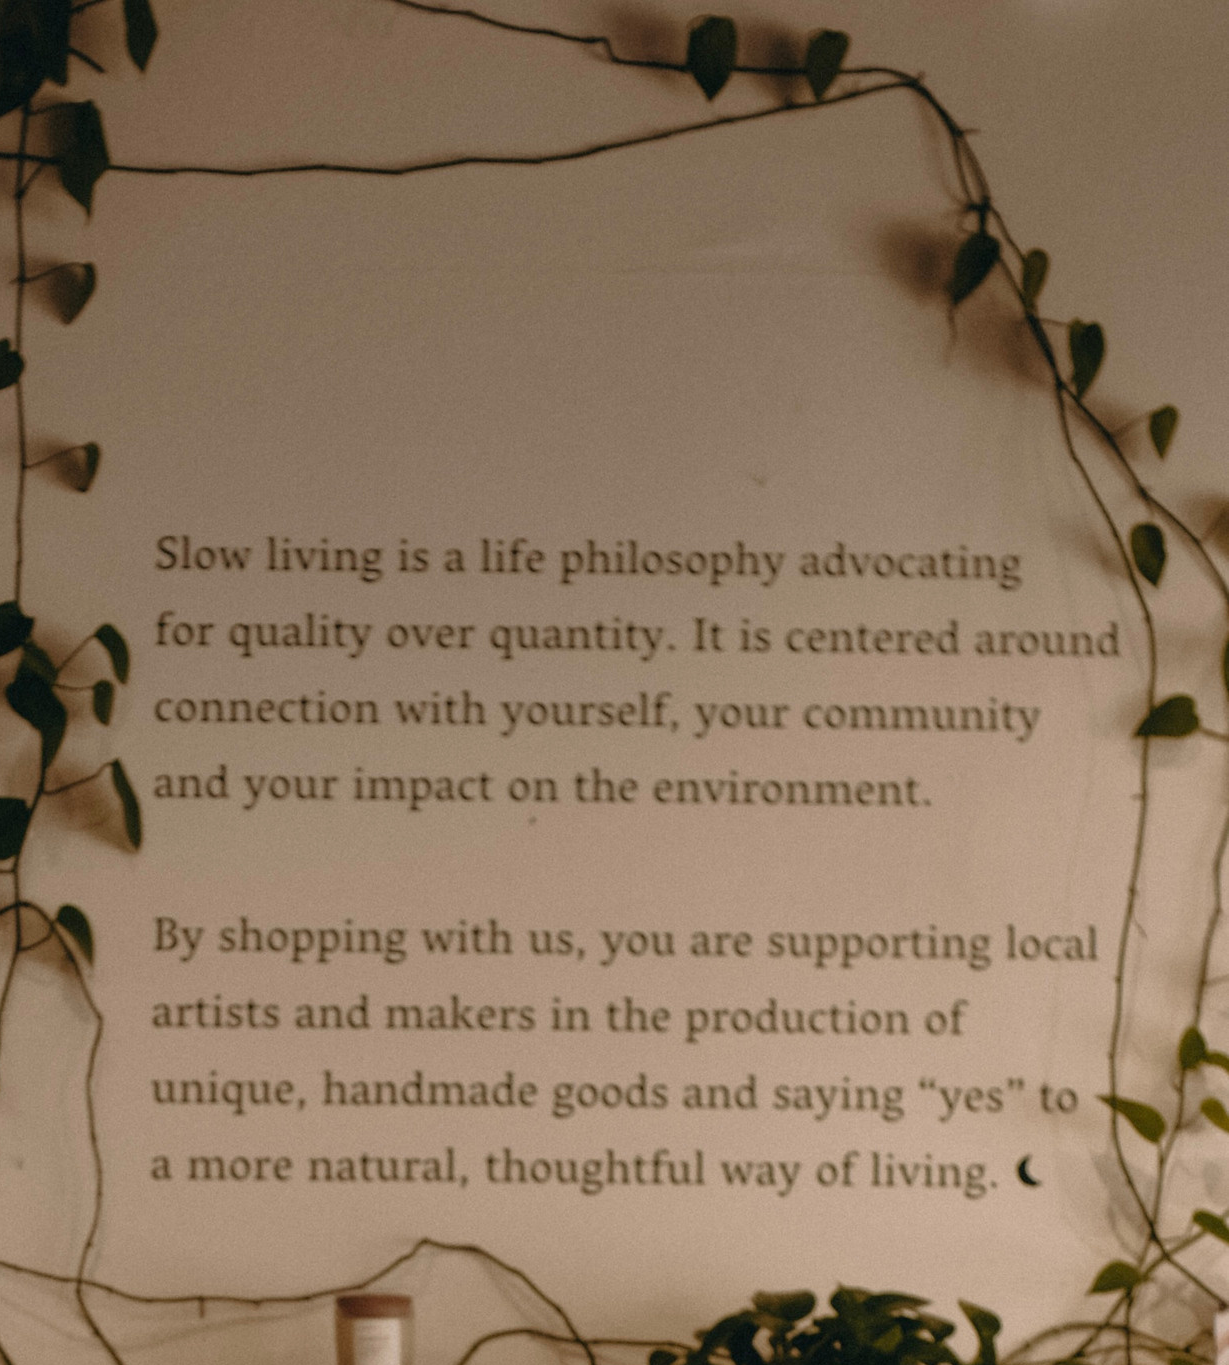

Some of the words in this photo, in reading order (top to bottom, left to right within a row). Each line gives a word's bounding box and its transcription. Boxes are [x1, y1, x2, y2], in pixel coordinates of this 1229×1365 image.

[154, 534, 253, 572] Slow
[265, 535, 385, 585] living
[397, 538, 431, 574] is
[443, 548, 467, 574] a
[479, 537, 546, 576] life
[559, 538, 786, 589] philosophy
[798, 541, 1024, 593] advocating
[154, 610, 216, 648] for
[227, 611, 374, 660] quality
[385, 623, 477, 651] over
[488, 616, 677, 664] quantity.
[692, 616, 725, 653] It
[739, 618, 772, 654] is
[784, 618, 961, 657] centered
[973, 620, 1121, 659] around
[153, 689, 381, 726] connection
[393, 689, 488, 727] with
[499, 690, 680, 739] yourself,
[692, 702, 791, 740] your
[802, 696, 1042, 745] community
[153, 763, 231, 803] and
[241, 774, 340, 812] your
[352, 766, 494, 814] impact
[506, 776, 560, 804] on
[572, 766, 639, 805] the
[652, 769, 932, 808] environment.
[152, 916, 205, 964] By
[217, 915, 408, 966] shopping
[420, 917, 514, 956] with
[527, 929, 586, 962] us,
[598, 930, 677, 969] you
[688, 930, 754, 959] are
[766, 924, 993, 973] supporting
[1005, 923, 1100, 963] local
[150, 993, 281, 1031] artists
[293, 992, 372, 1031] and
[384, 993, 537, 1033] makers
[550, 995, 593, 1033] in
[604, 995, 672, 1035] the
[684, 996, 911, 1046] production
[923, 998, 970, 1037] of
[150, 1069, 307, 1117] unique,
[321, 1069, 539, 1109] handmade
[550, 1071, 670, 1121] goods
[681, 1073, 759, 1111] and
[772, 1075, 906, 1125] saying
[1039, 1083, 1080, 1114] to
[149, 1154, 174, 1182] a
[186, 1155, 294, 1183] more
[307, 1145, 470, 1190] natural,
[484, 1146, 706, 1197] thoughtful
[719, 1160, 803, 1199] way
[814, 1149, 861, 1188] of
[870, 1150, 999, 1202] living.
